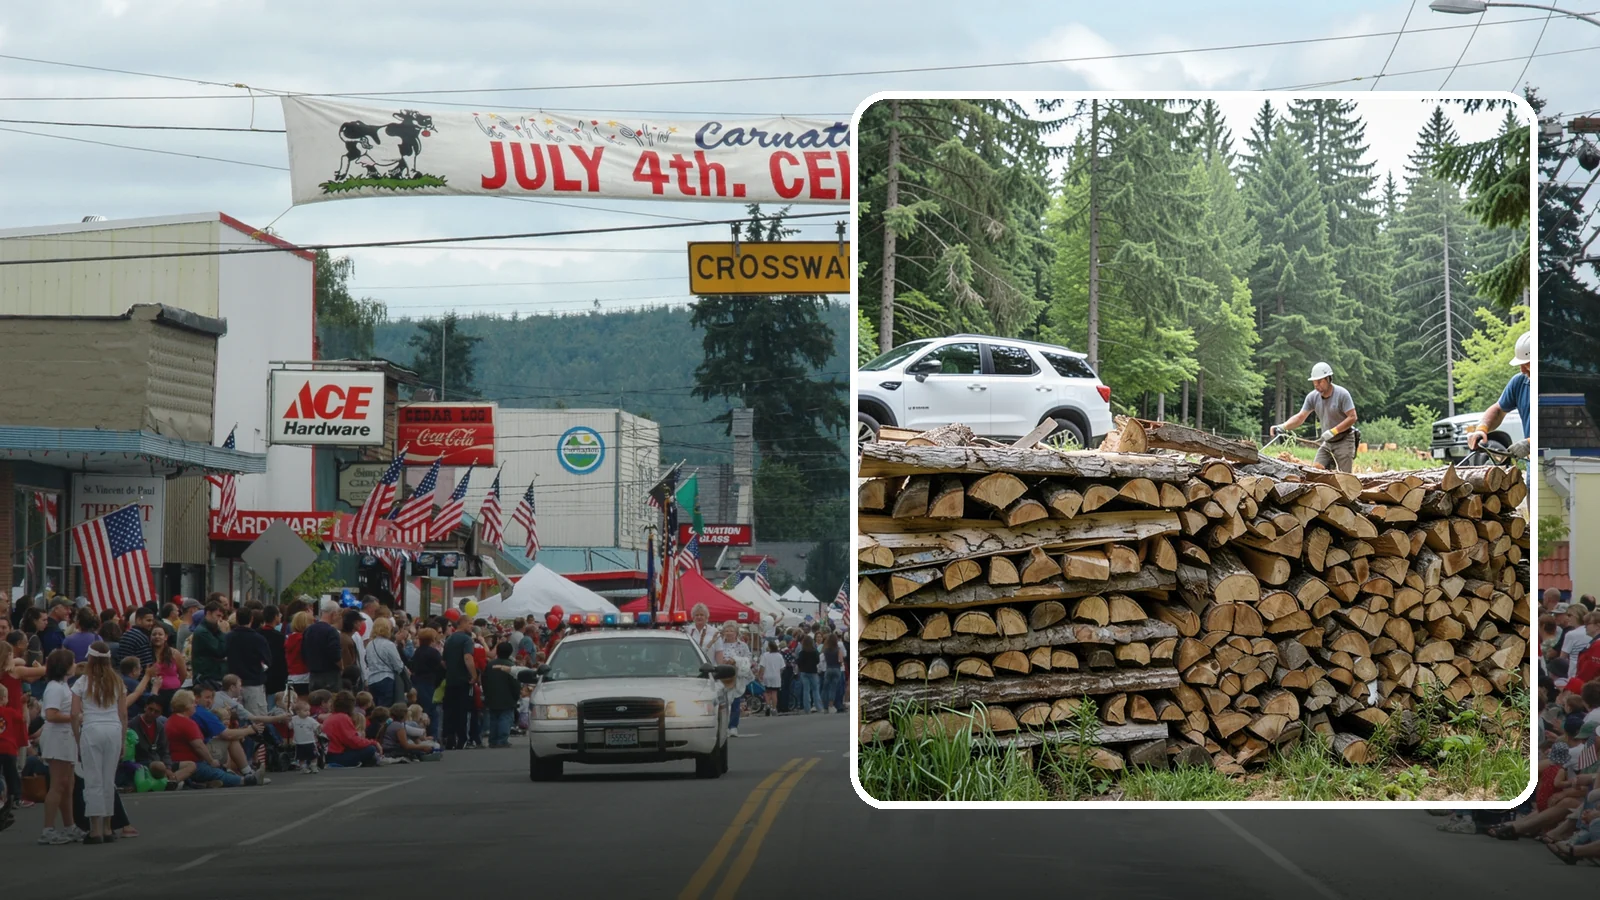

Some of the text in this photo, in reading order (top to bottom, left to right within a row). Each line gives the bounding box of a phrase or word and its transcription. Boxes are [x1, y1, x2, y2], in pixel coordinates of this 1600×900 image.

[481, 141, 605, 193] JULY
[632, 150, 746, 198] 4th.
[696, 254, 850, 280] CROSSWA
[282, 380, 373, 420] ACE
[405, 409, 452, 422] CEDAR
[283, 421, 370, 436] Hardware
[416, 428, 476, 447] Coca-Cola
[83, 484, 155, 495] St. Vincent de Paul
[688, 526, 741, 535] CRNATION
[699, 535, 730, 543] GLASS
